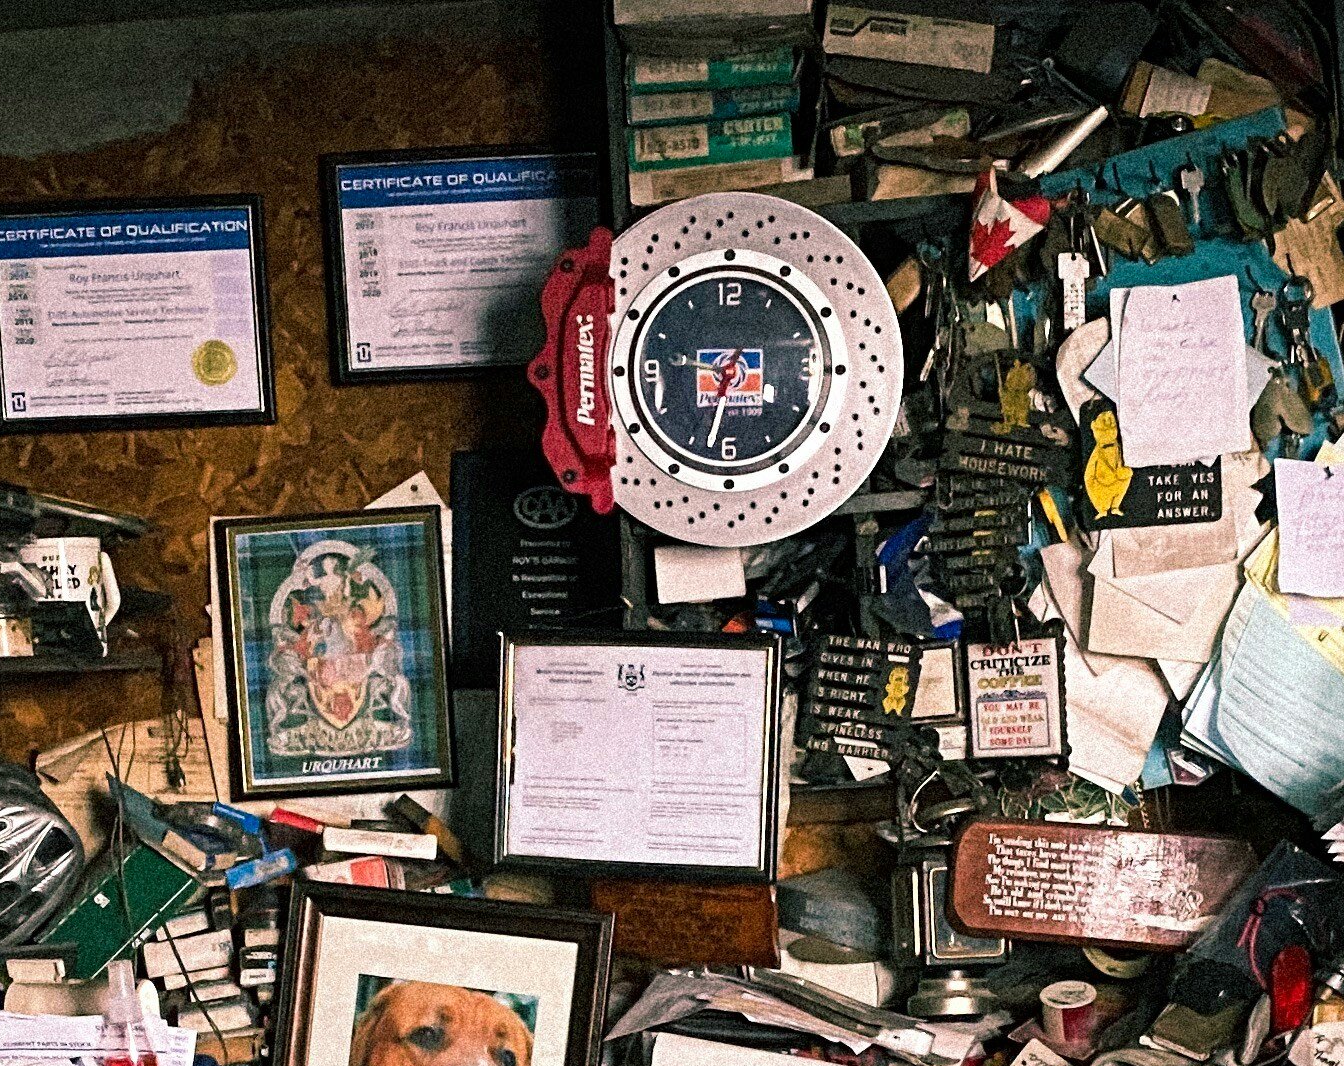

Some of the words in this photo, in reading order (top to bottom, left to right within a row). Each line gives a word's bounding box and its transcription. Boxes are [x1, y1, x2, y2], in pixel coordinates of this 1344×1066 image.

[341, 176, 443, 191] CERTIFICATE
[446, 174, 468, 185] OF
[100, 225, 121, 237] OF
[125, 220, 248, 237] QUALIFICATION
[718, 283, 742, 306] 12
[576, 318, 594, 426] Permatex
[645, 360, 659, 383] 9
[721, 437, 737, 460] 6
[994, 445, 1033, 460] HATE
[959, 456, 1048, 481] HOUSEWORK
[1148, 473, 1179, 486] TAKE
[1191, 473, 1215, 484] YES
[1156, 491, 1182, 502] FOR
[1193, 489, 1208, 500] AN
[1157, 506, 1216, 519] ANSWER.
[829, 635, 851, 647] THE
[857, 639, 880, 652] MAN
[887, 642, 911, 654] WHO
[982, 642, 1043, 656] DON'T
[820, 652, 854, 666] GIVES
[861, 656, 874, 668] IN
[970, 655, 1051, 671] CRITICIZE
[817, 670, 849, 682] WHEN
[855, 673, 870, 685] HE
[996, 667, 1025, 676] THE
[977, 675, 1042, 690] COFFEE
[983, 703, 1000, 712] YOU
[1005, 702, 1023, 711] MAY
[1028, 701, 1041, 710] BE
[820, 722, 883, 740] SPINELESS
[989, 725, 1033, 736] YOURSELF
[806, 739, 829, 752] AND
[302, 756, 382, 774] URQUHART
